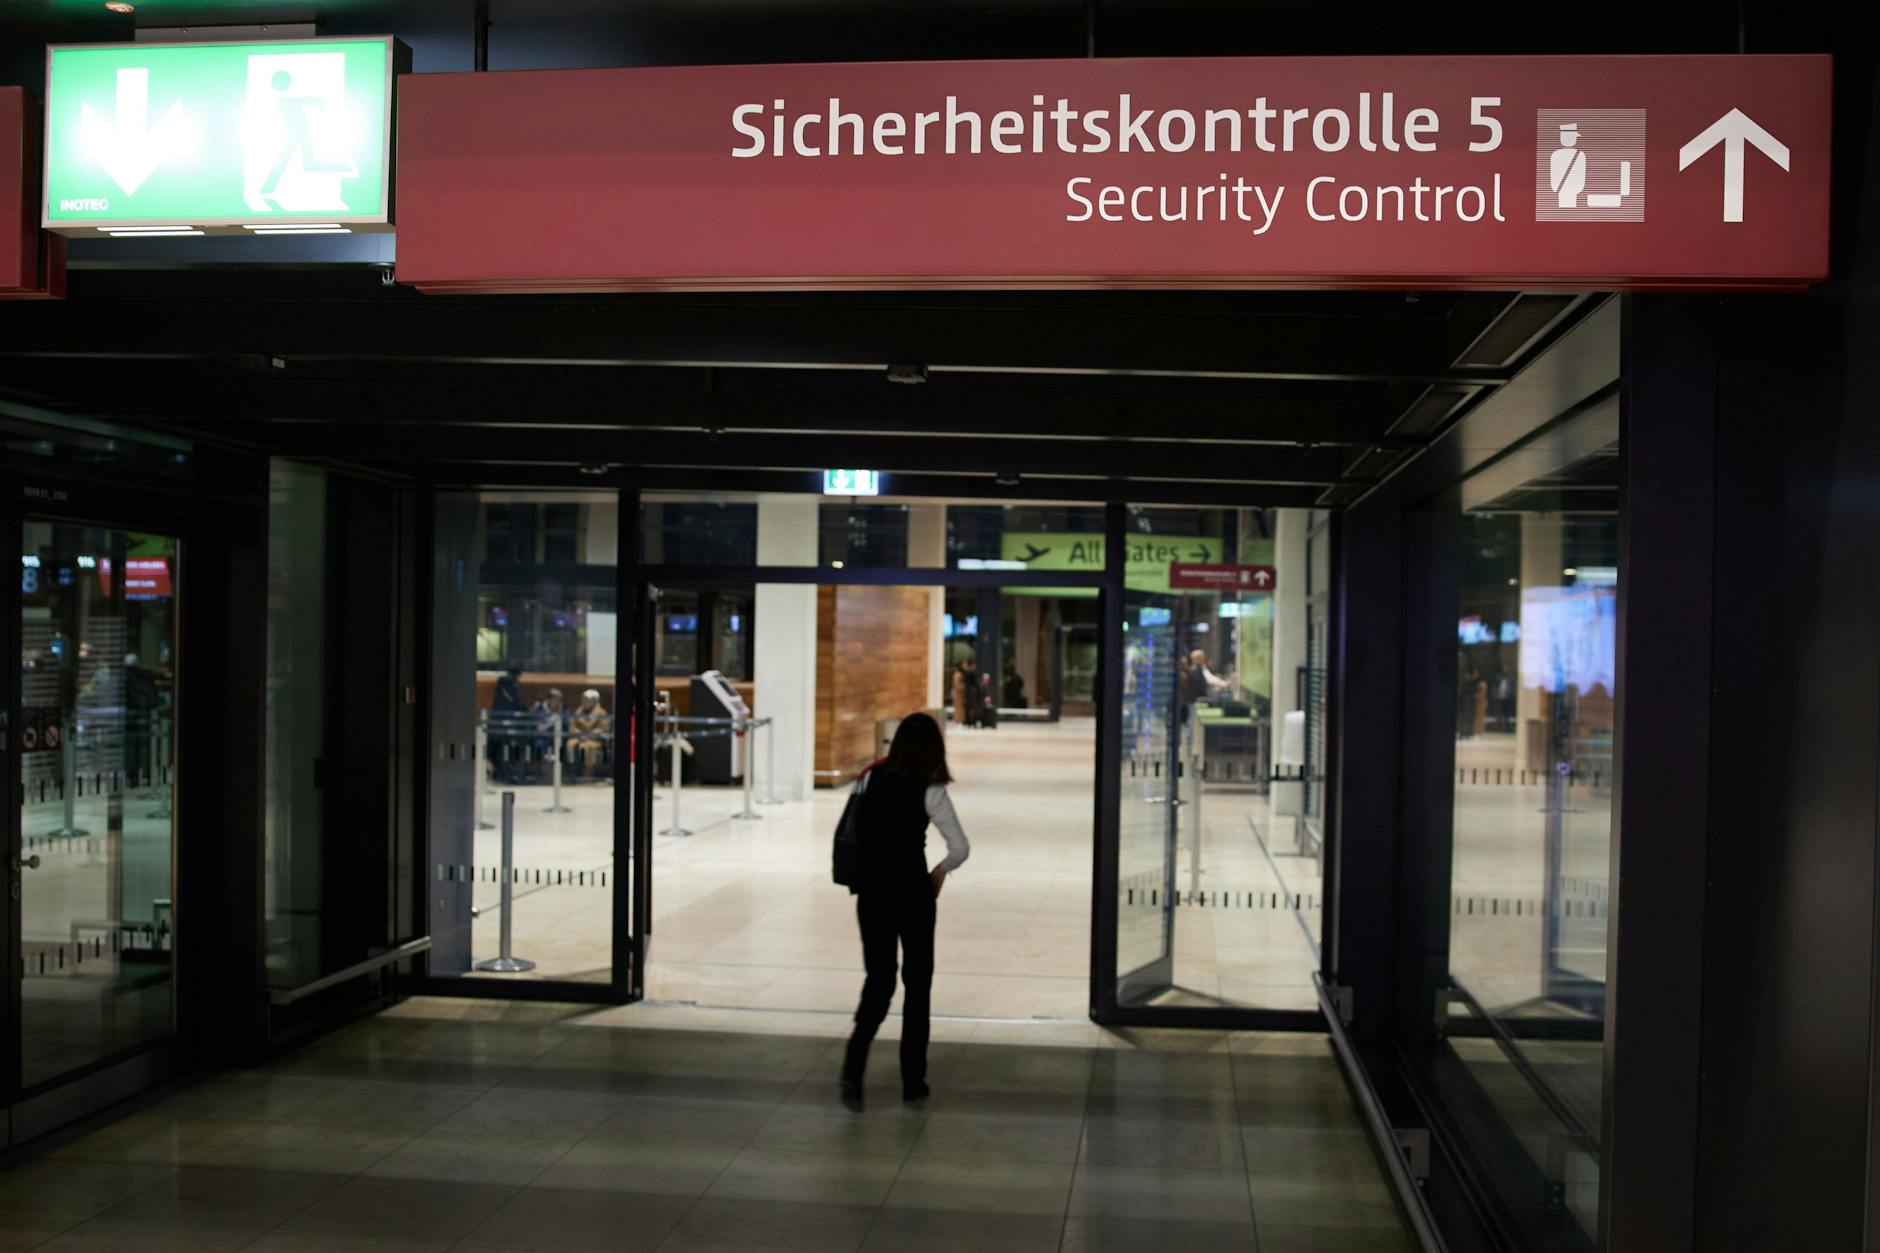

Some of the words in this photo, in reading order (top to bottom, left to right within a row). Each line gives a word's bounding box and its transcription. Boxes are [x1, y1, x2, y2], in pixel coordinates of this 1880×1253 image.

[732, 93, 1438, 157] Sicherheitskontrolle
[1469, 97, 1502, 152] 5
[60, 198, 109, 212] INOTEC
[1067, 174, 1284, 234] Security
[1307, 174, 1505, 221] Control
[1068, 541, 1100, 563] All
